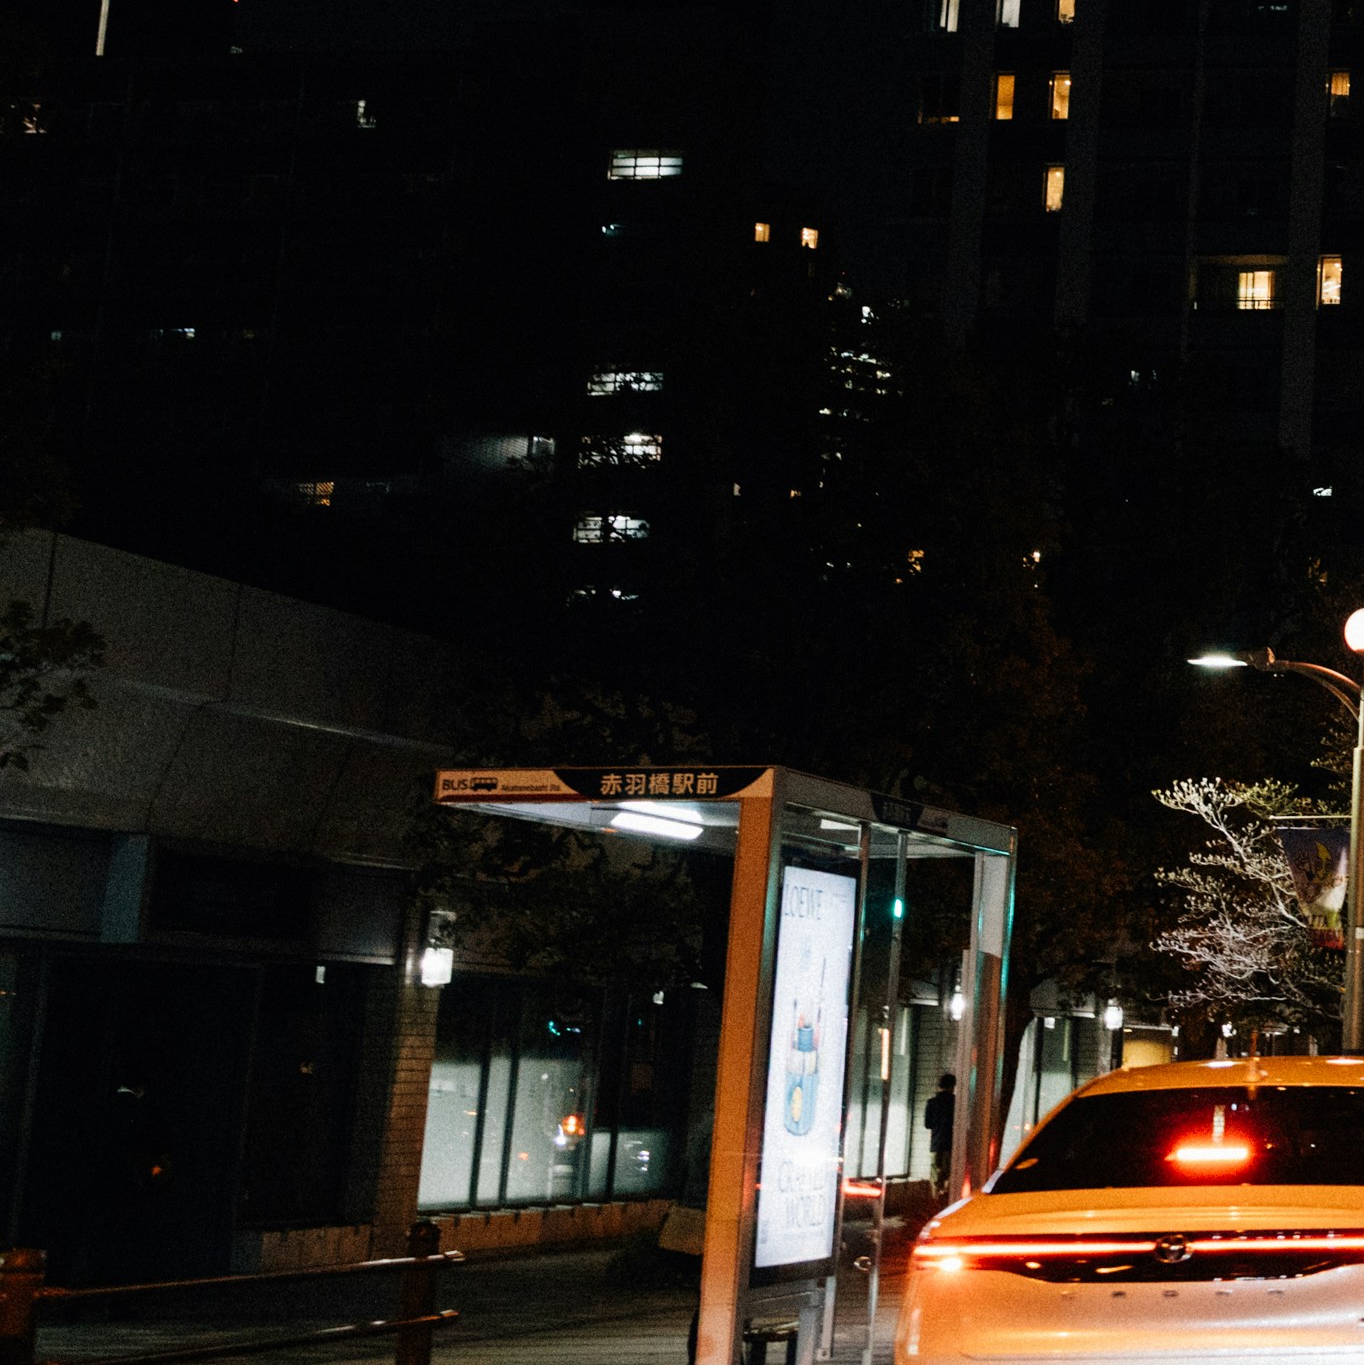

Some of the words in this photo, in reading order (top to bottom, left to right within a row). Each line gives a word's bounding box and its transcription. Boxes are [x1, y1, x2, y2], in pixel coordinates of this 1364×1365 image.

[442, 779, 468, 791] BUS
[600, 772, 719, 796] 赤羽橋駅前
